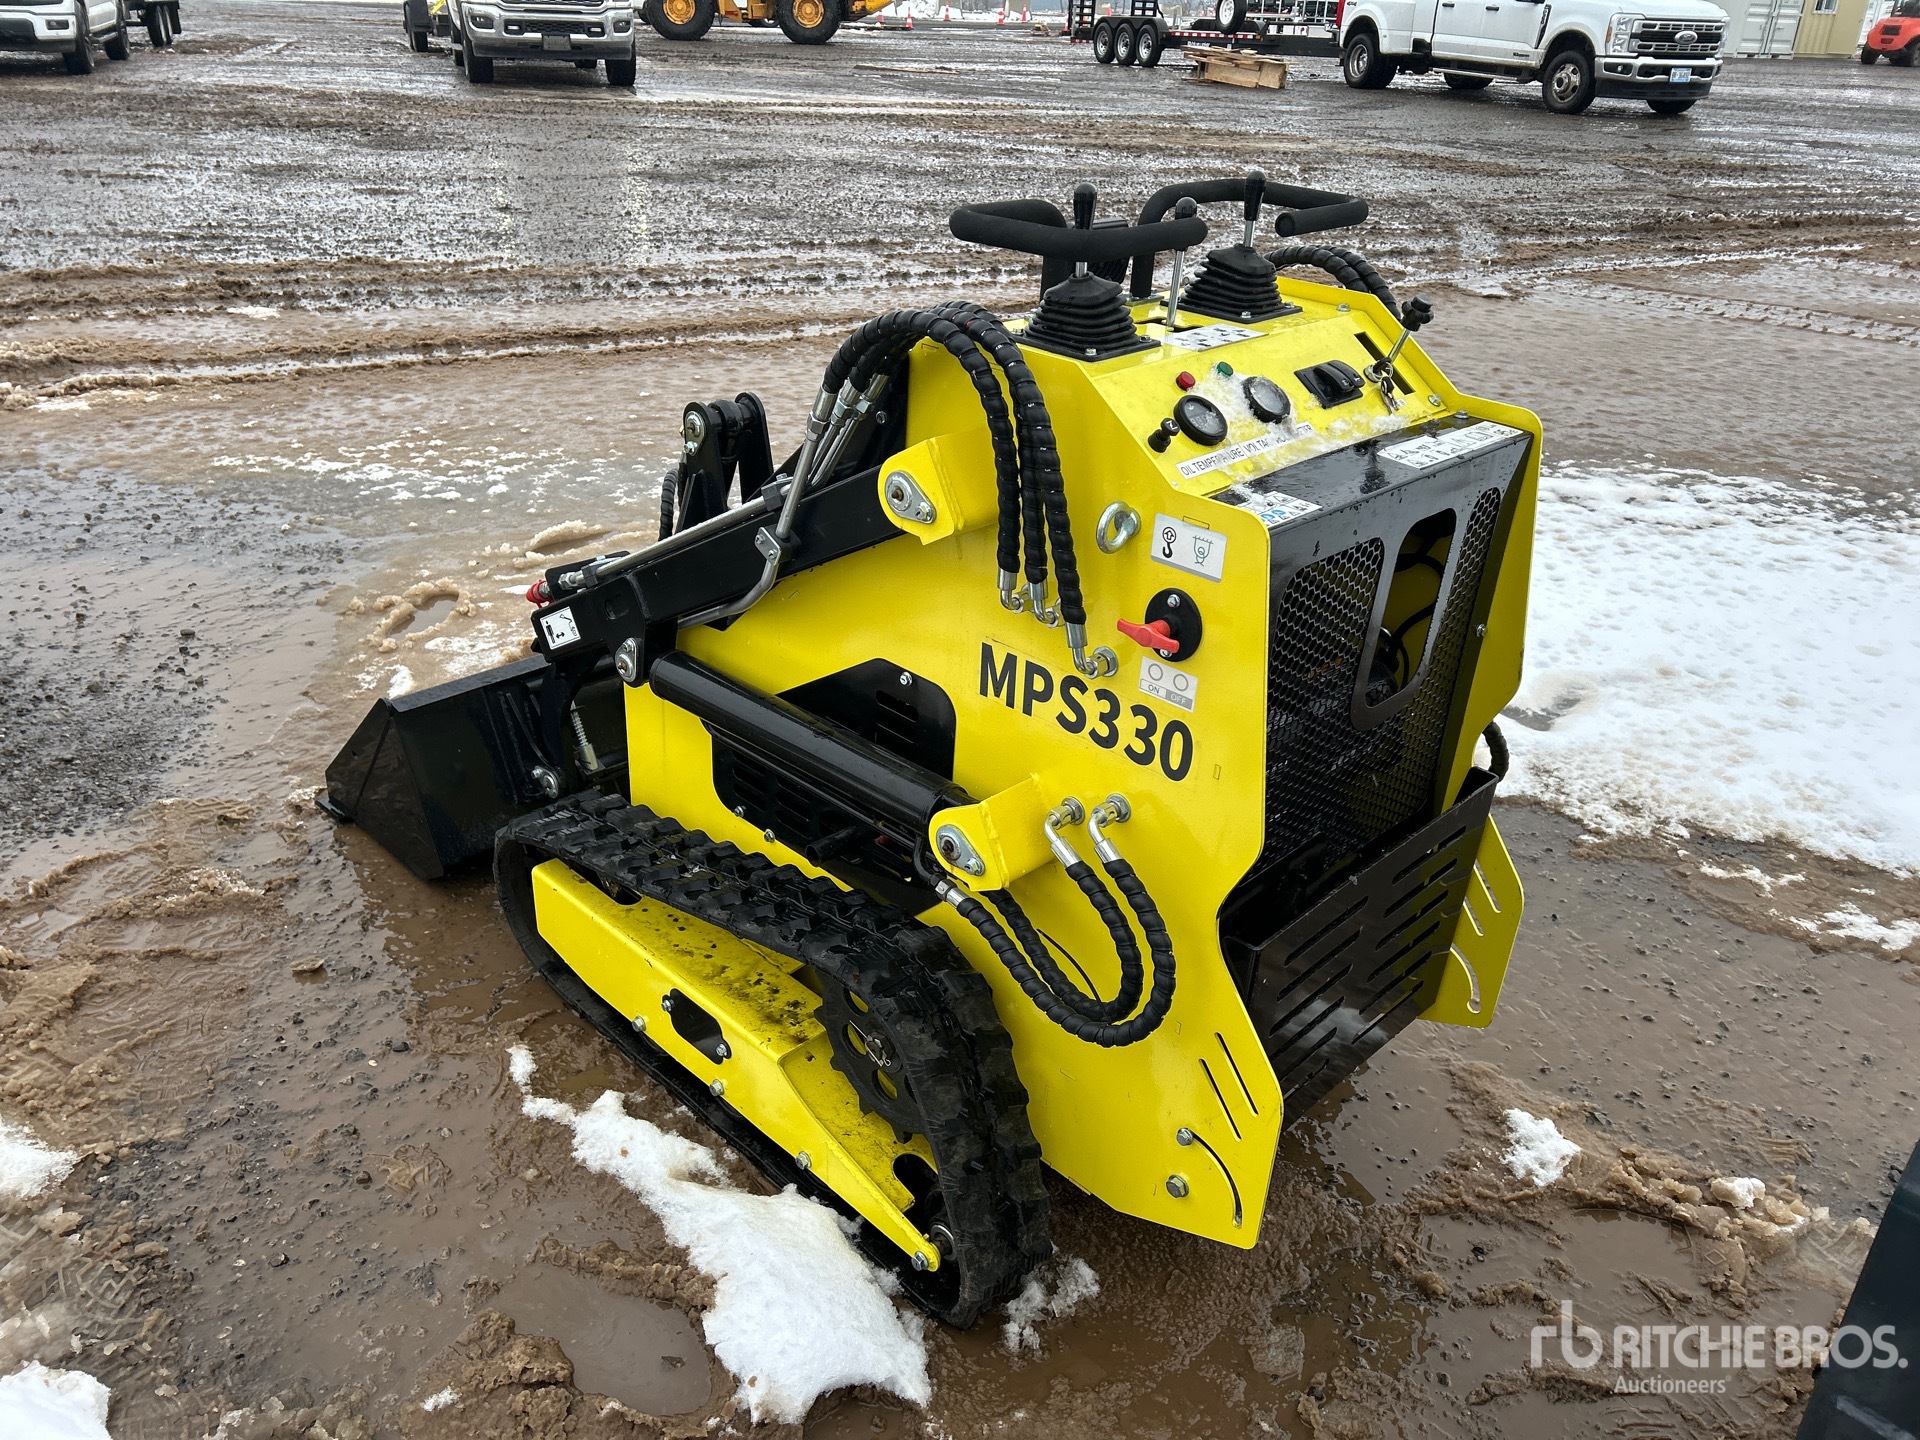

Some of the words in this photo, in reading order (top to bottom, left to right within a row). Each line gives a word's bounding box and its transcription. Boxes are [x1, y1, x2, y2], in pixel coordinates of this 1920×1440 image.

[1180, 464, 1196, 476] OIL
[1147, 683, 1160, 694] ON
[1170, 693, 1187, 704] OFF
[979, 641, 1194, 782] MPS330
